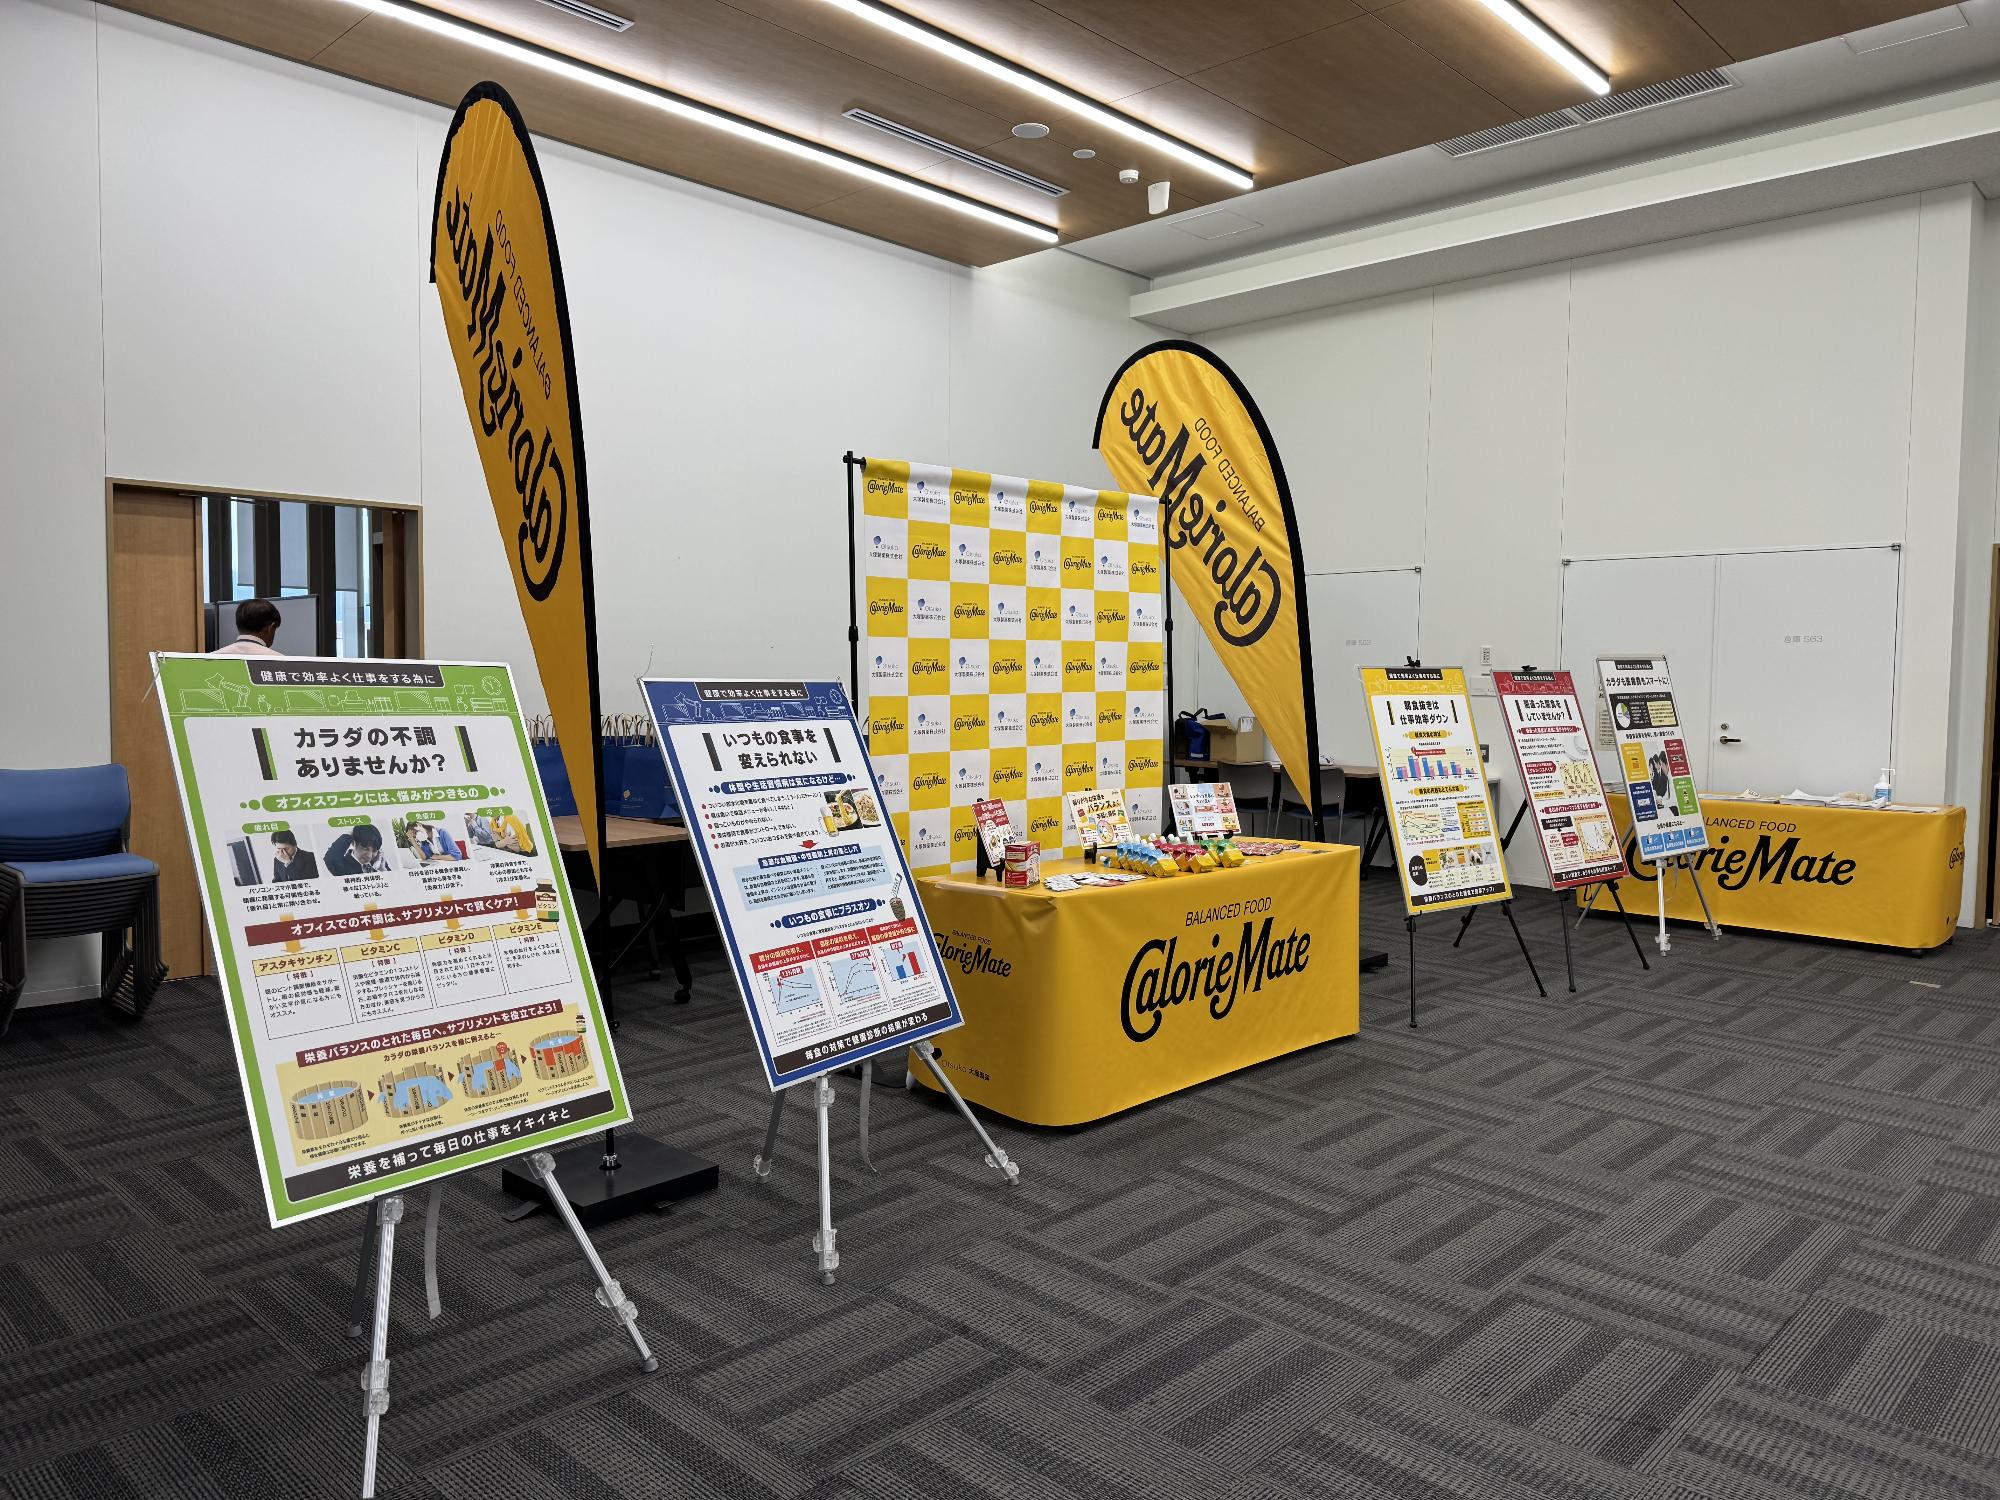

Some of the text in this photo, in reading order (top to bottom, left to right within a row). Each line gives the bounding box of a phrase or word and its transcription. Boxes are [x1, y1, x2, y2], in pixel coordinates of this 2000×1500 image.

[868, 480, 903, 494] CalorieMate
[912, 544, 946, 559] CalorieMate
[870, 601, 903, 616] CalorieMate
[913, 662, 945, 675] CalorieMate
[259, 669, 436, 685] 健康で効率よく仕事をする為に
[1399, 713, 1449, 725] 仕事効率ダウン
[1526, 712, 1565, 721] していませんか？
[872, 720, 904, 734] CalorieMate
[293, 725, 438, 749] カラダの不調
[721, 728, 818, 748] いつもの食事を
[295, 753, 446, 779] ありませんか？
[736, 748, 819, 769] 変えられない
[913, 776, 946, 790] CalorieMate
[274, 786, 479, 810] オフィスワークには、悩みがつきもの
[335, 816, 363, 825] ストレス
[1759, 820, 1797, 833] FOOD
[787, 900, 871, 926] いつもの食事にプラスオン
[1185, 897, 1272, 927] BALANCED FOOD
[509, 922, 542, 934] ビタミンE
[437, 931, 475, 944] ビタミンD
[360, 942, 401, 956] ビタミンC
[258, 952, 333, 972] アスタキサンチン
[1120, 916, 1312, 1043] CalorieMate
[304, 1001, 557, 1064] 栄養バランスのとれた毎日へ。サプリメントを役立てよう！
[803, 1012, 929, 1061] 毎食の対策で健康診断の結果が変わる
[346, 1104, 571, 1181] 栄養を補って毎日の仕事をイキイキと
